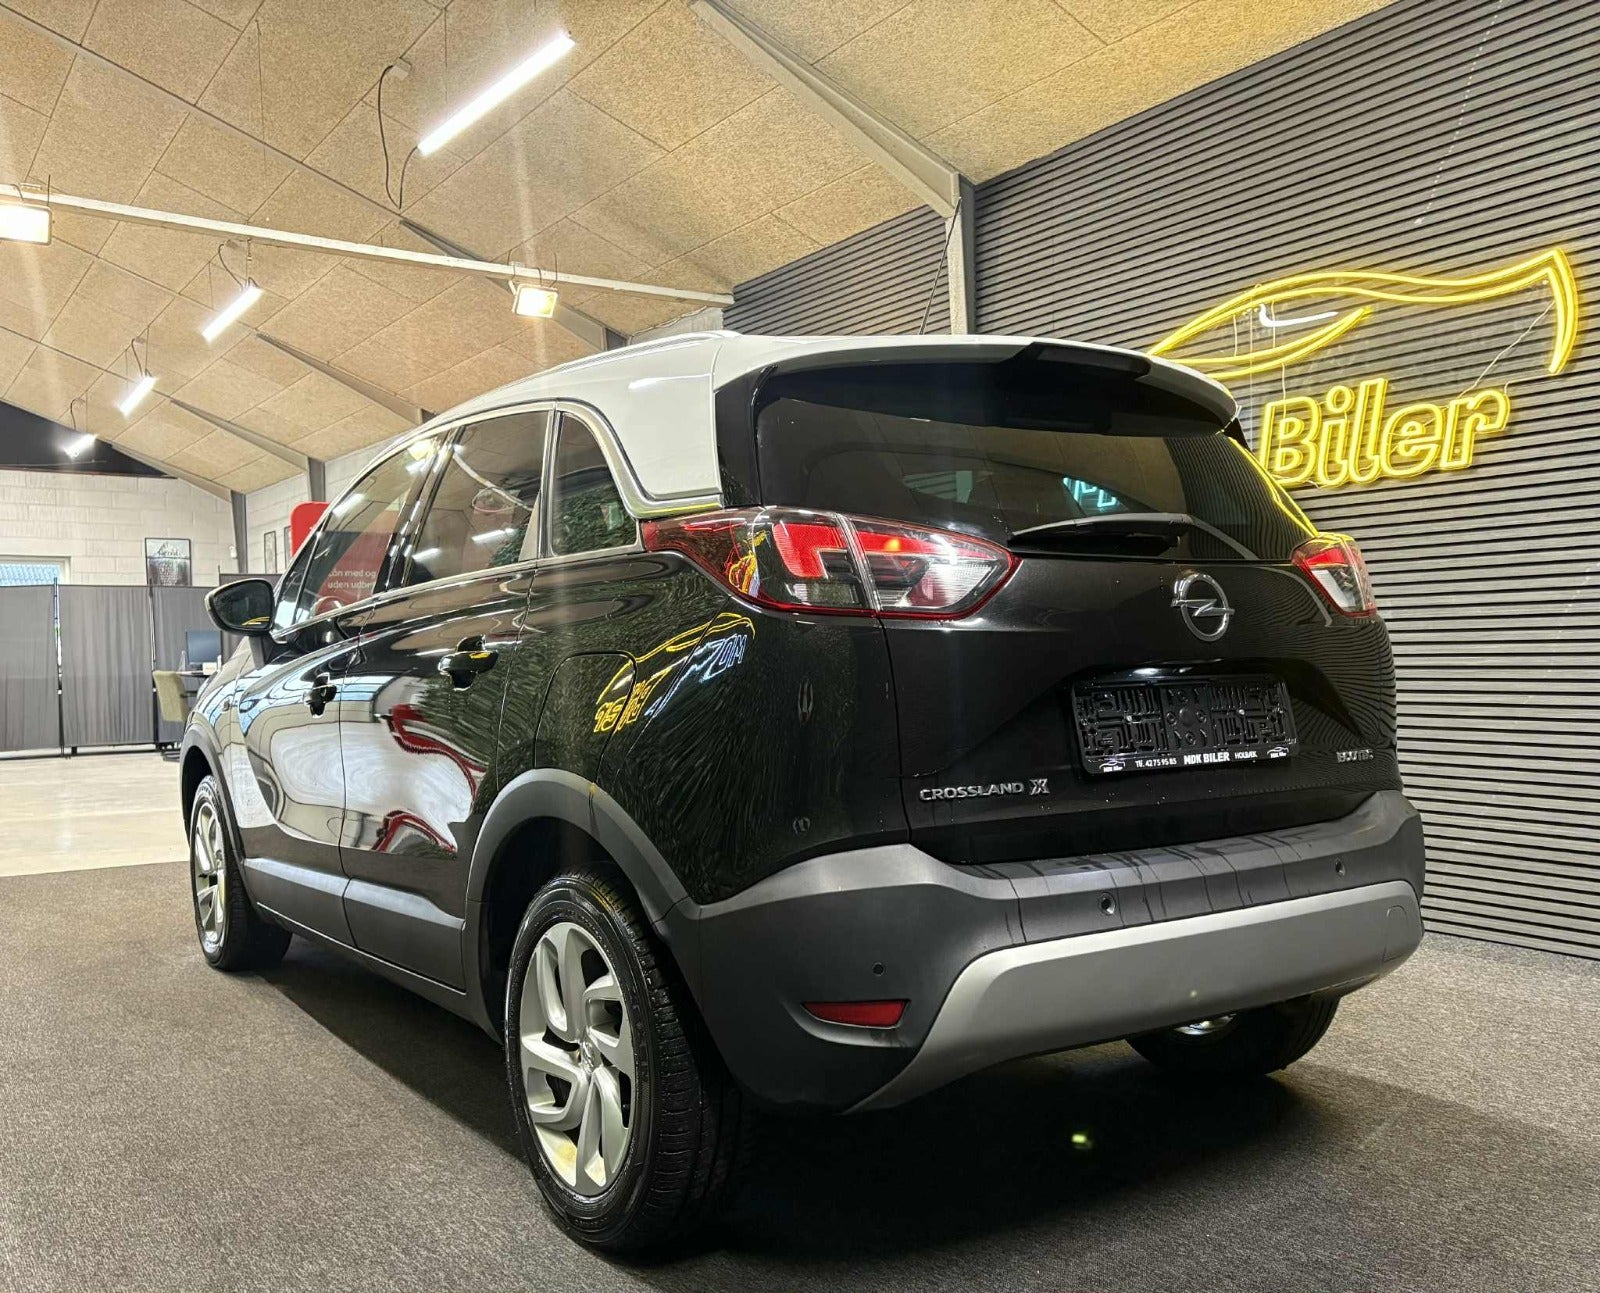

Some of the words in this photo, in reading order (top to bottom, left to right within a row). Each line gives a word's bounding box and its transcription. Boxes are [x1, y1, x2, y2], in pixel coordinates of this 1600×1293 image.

[1260, 378, 1511, 488] Biler
[344, 569, 363, 577] med
[364, 571, 376, 580] og
[328, 580, 349, 589] uden
[1183, 754, 1202, 765] MDK
[1203, 752, 1230, 764] BILER
[919, 782, 1024, 801] CROSSLAND
[1029, 778, 1051, 796] X
